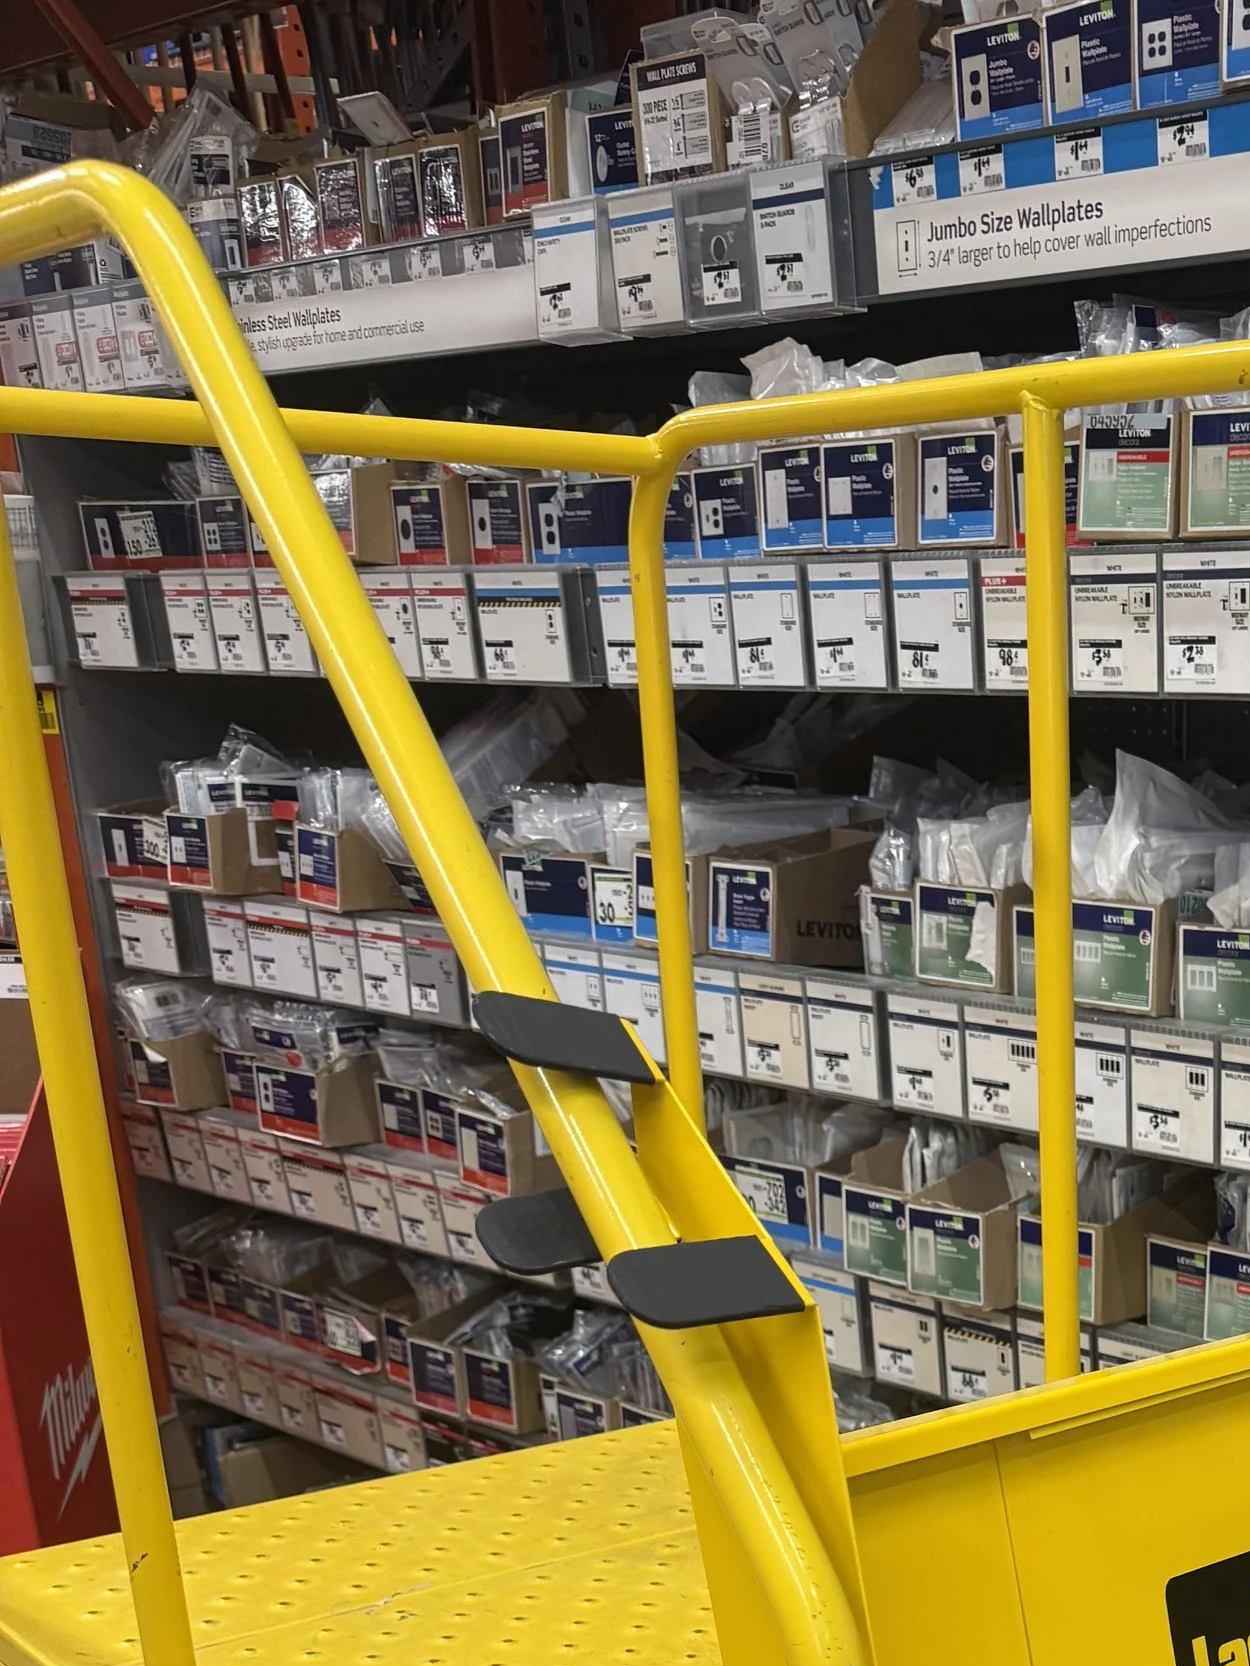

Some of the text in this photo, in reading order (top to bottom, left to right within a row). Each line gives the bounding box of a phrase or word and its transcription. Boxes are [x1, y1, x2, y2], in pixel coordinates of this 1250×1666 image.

[987, 31, 1020, 47] LEVITON
[660, 65, 675, 79] PLATE
[676, 62, 696, 76] SCREWS
[927, 200, 1104, 242] Jumbo Size Wallplates
[928, 215, 1212, 270] 3/4" larger to help cover wall imperfections
[267, 312, 292, 330] Steel
[293, 307, 341, 329] Wallplates
[257, 320, 424, 354] stylish upgrade for home and commercial use
[1119, 428, 1151, 438] LEVITON
[796, 921, 861, 941] LEVITO
[1217, 940, 1250, 950] LEVITON
